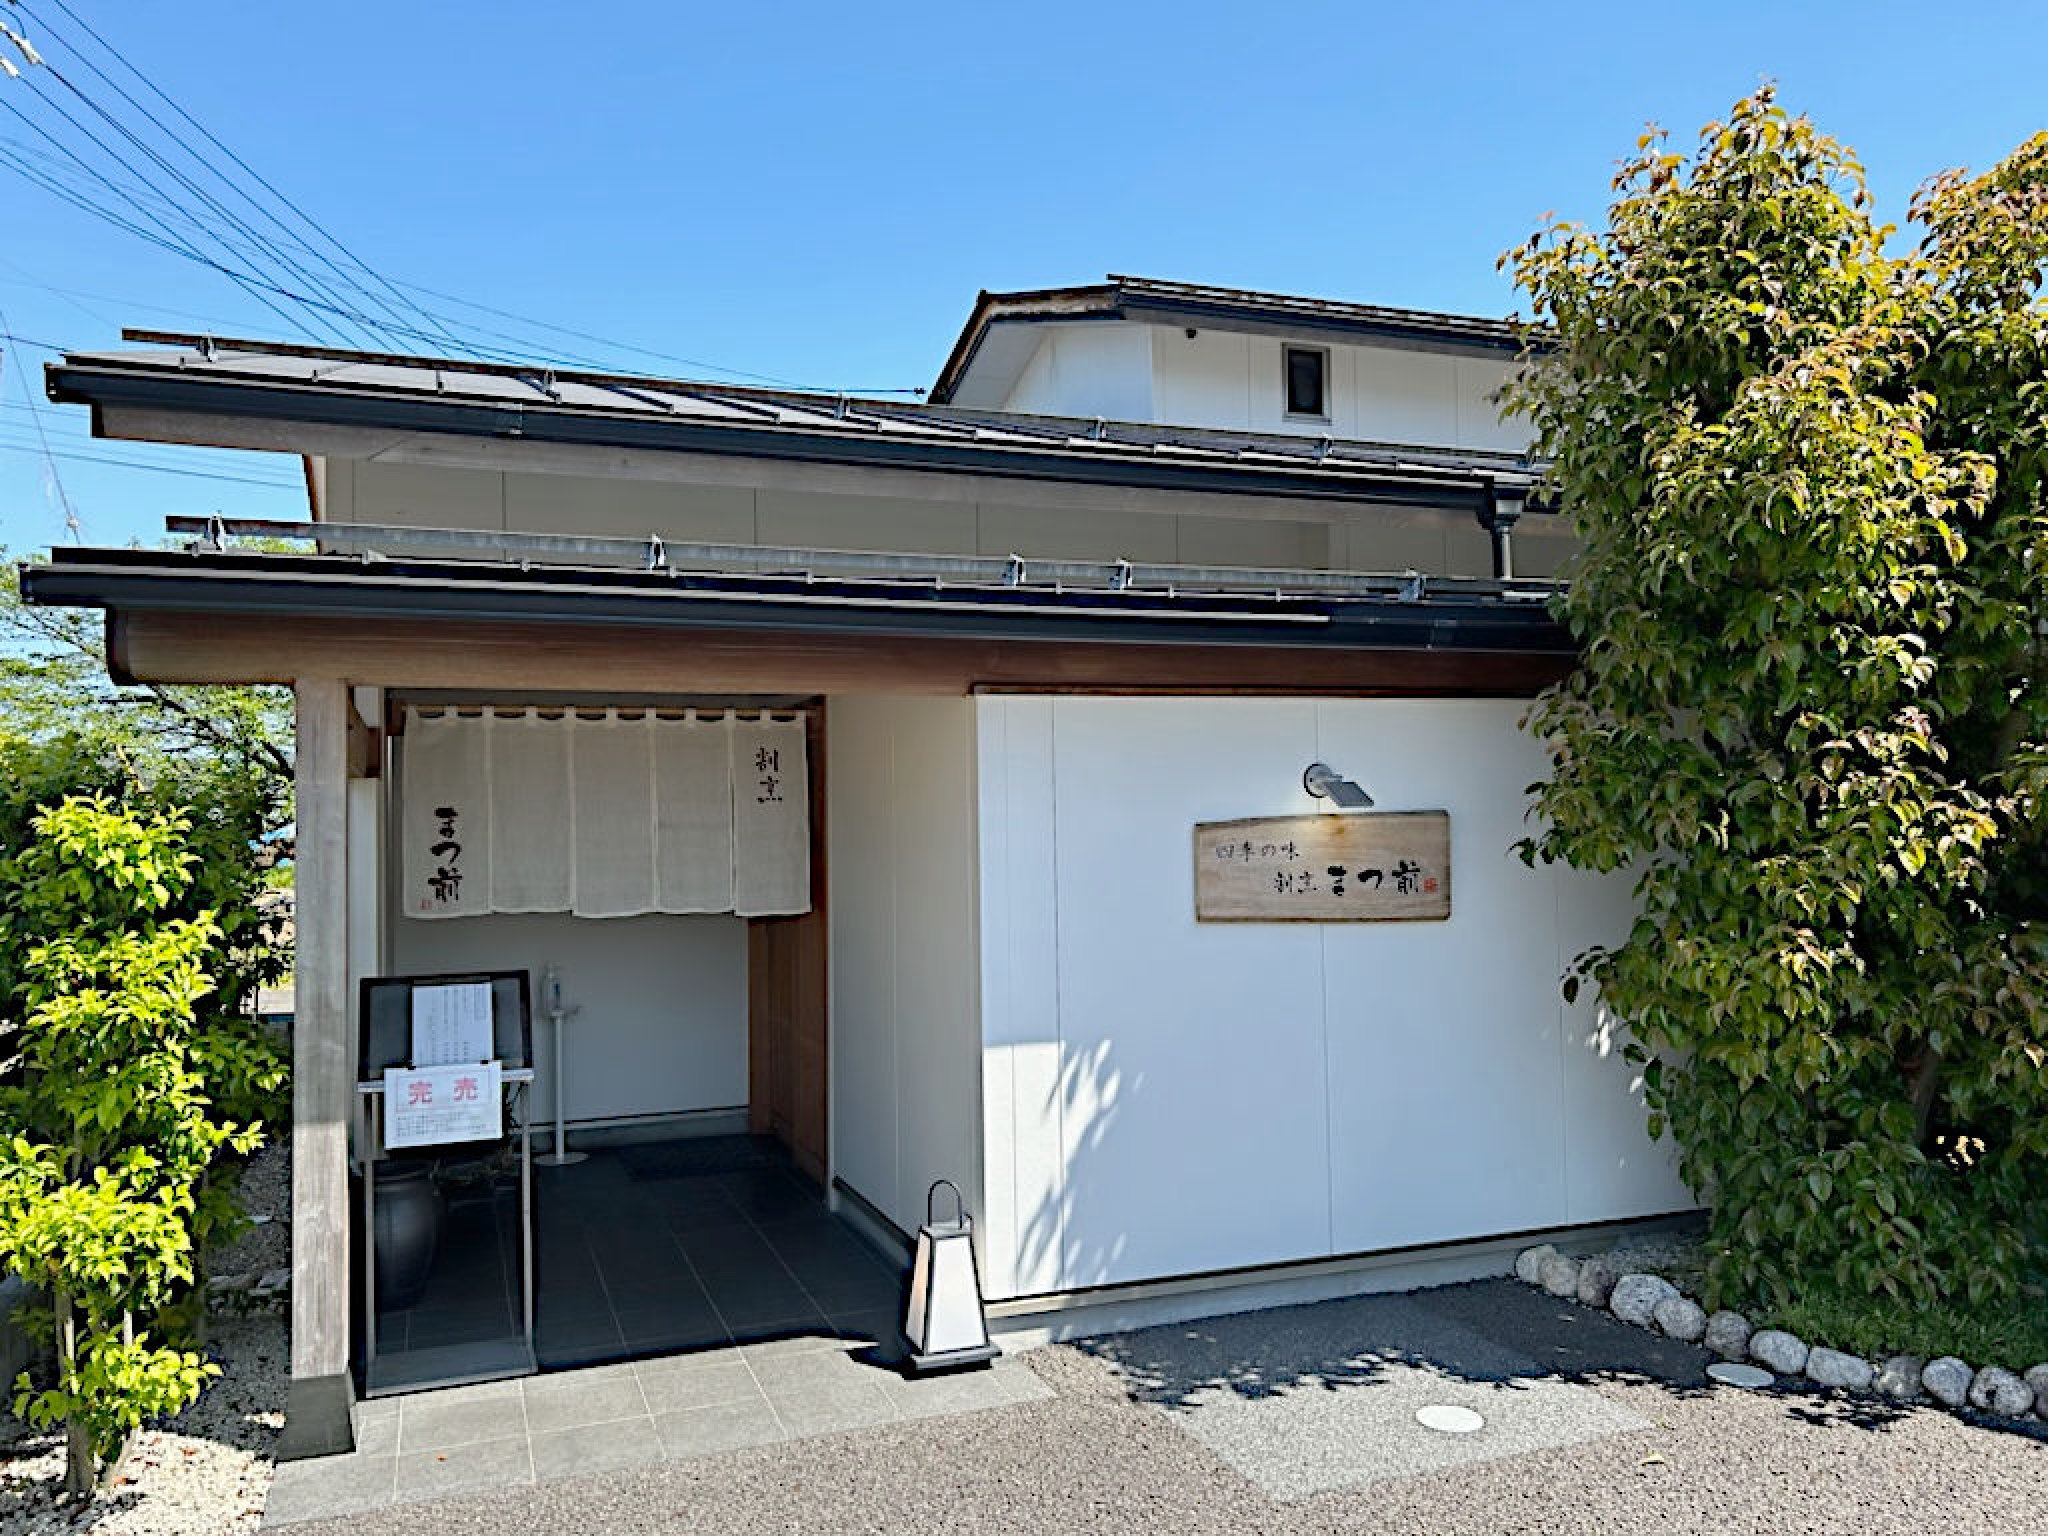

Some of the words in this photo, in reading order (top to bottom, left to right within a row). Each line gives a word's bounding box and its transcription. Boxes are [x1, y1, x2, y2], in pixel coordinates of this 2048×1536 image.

[427, 807, 463, 903] まつ前
[408, 1077, 478, 1105] 完売
